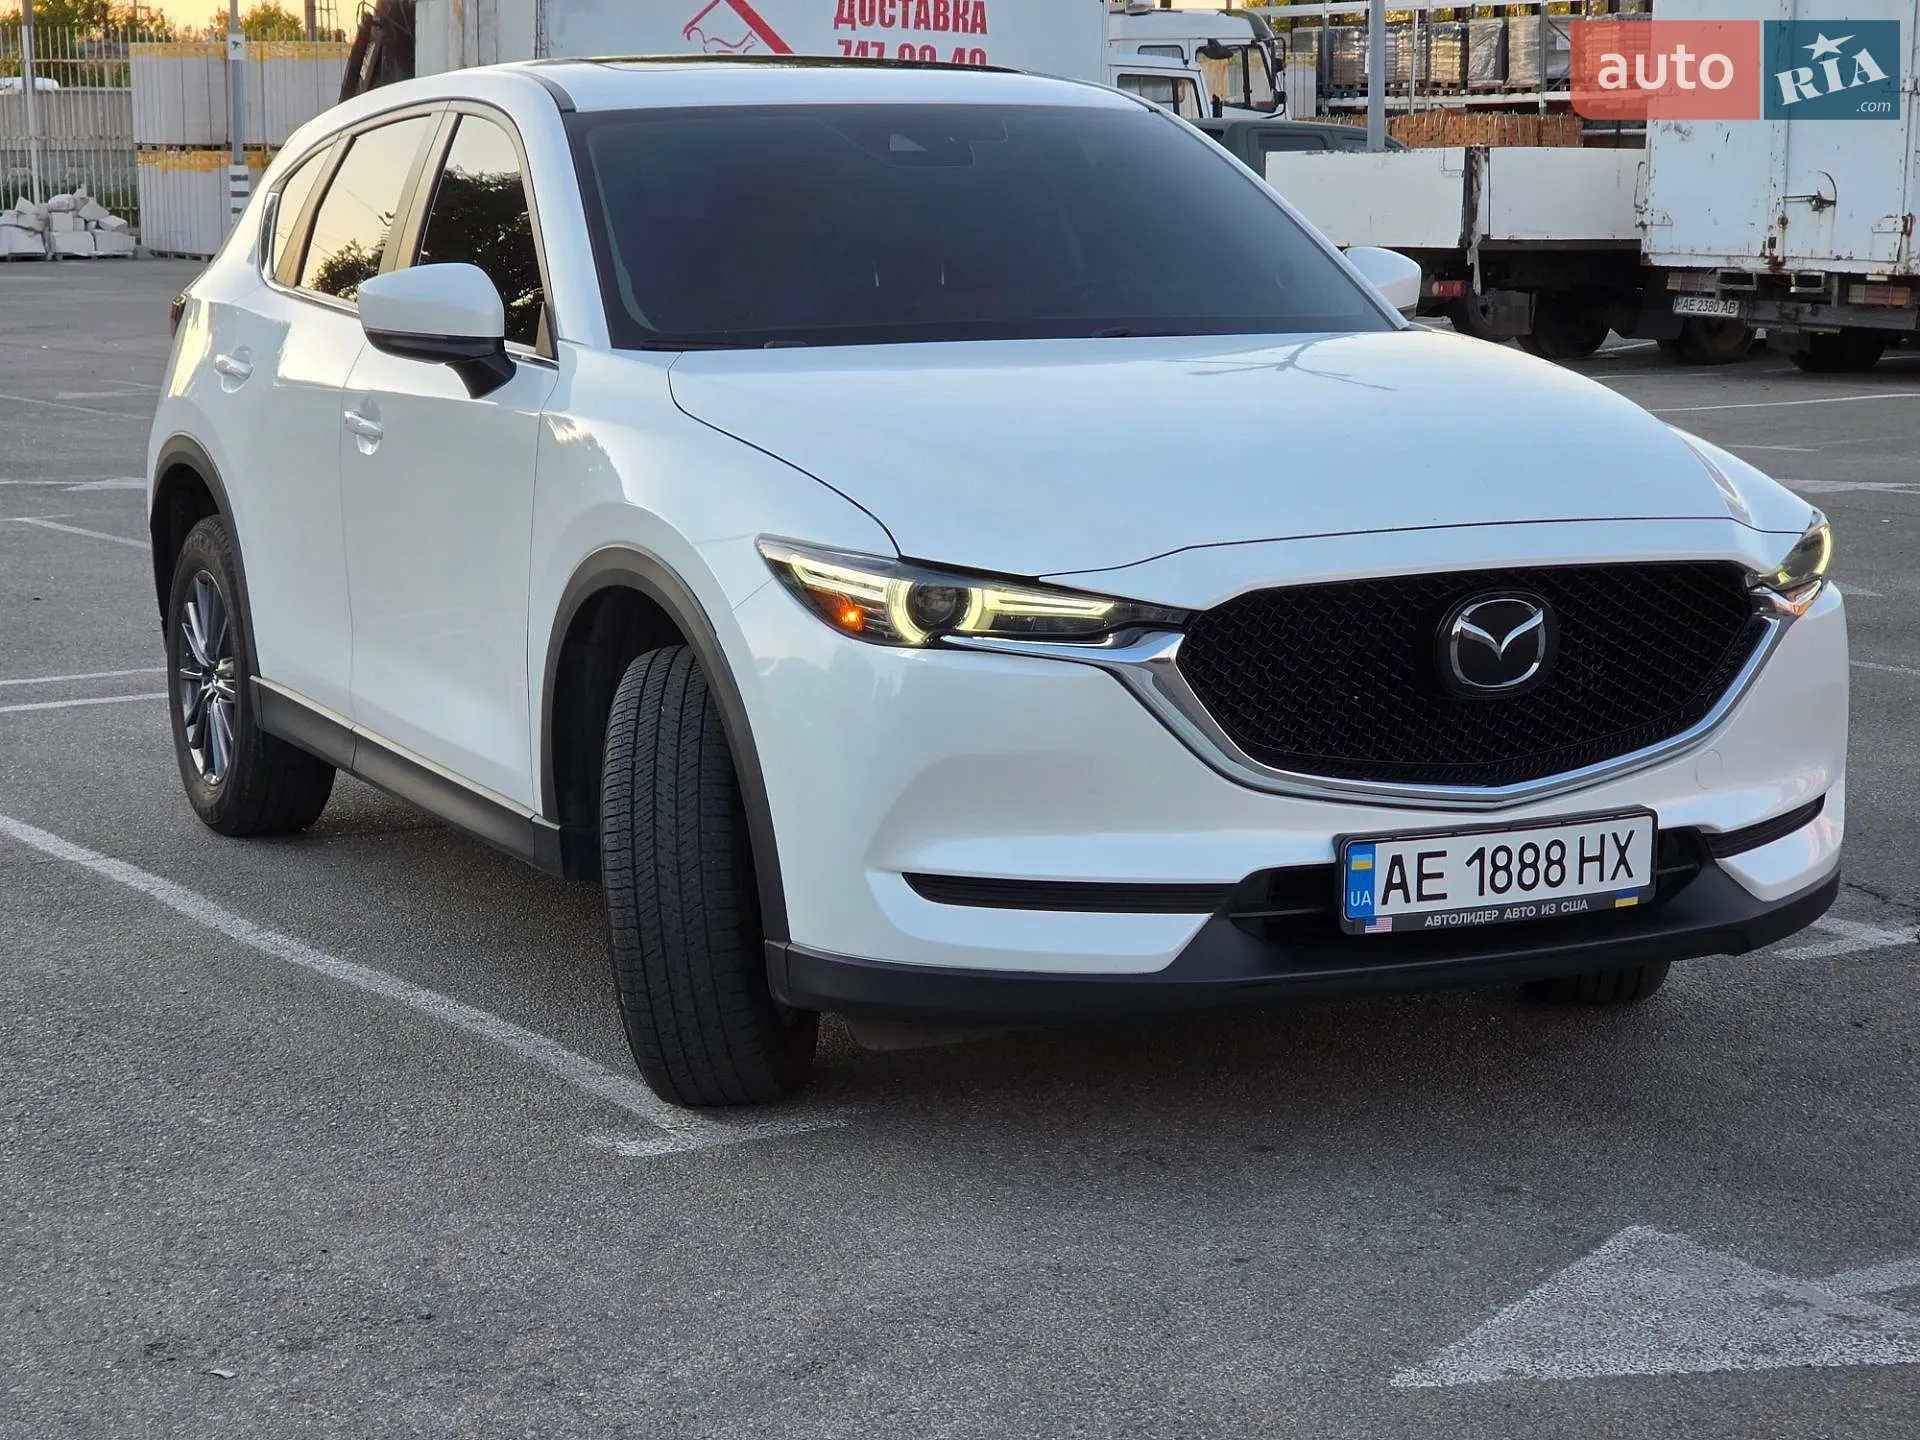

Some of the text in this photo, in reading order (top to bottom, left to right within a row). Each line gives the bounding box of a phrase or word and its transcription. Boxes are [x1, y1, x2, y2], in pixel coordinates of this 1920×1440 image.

[833, 0, 988, 35] ДОСТАВКА
[1682, 299, 1736, 314] AE 2380 AB
[1381, 829, 1635, 906] AE 1888 HX
[1350, 890, 1372, 907] UA
[1424, 899, 1588, 928] АВТОЛИДЕР АВТО ИЗ США
